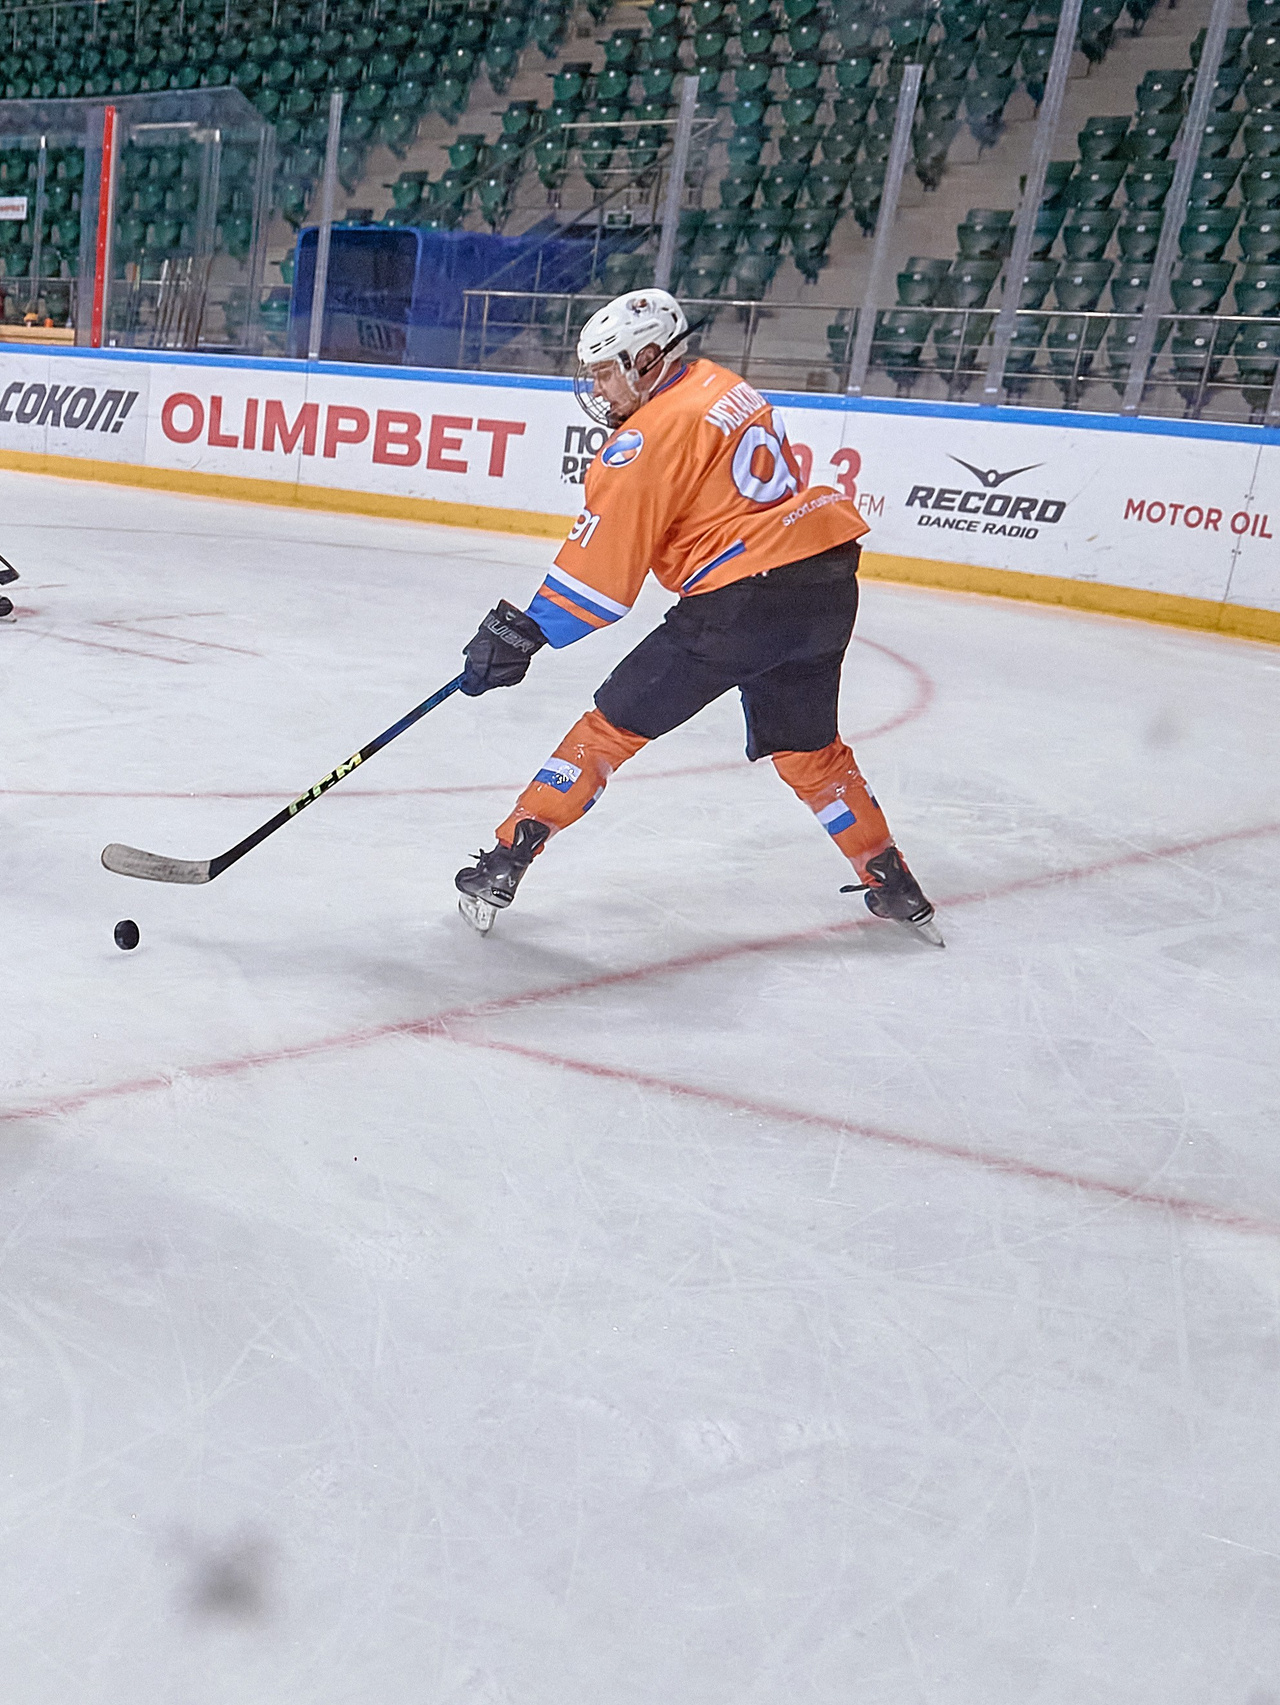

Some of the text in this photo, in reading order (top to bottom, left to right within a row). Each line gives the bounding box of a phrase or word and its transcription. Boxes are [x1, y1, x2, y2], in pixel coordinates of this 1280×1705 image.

[160, 391, 527, 478] OLIMPBET
[858, 493, 885, 518] FM
[905, 485, 1067, 524] RECORD
[1123, 498, 1273, 539] MOTOR OIL
[567, 508, 601, 549] 91
[917, 514, 1039, 540] DANCE RADIO
